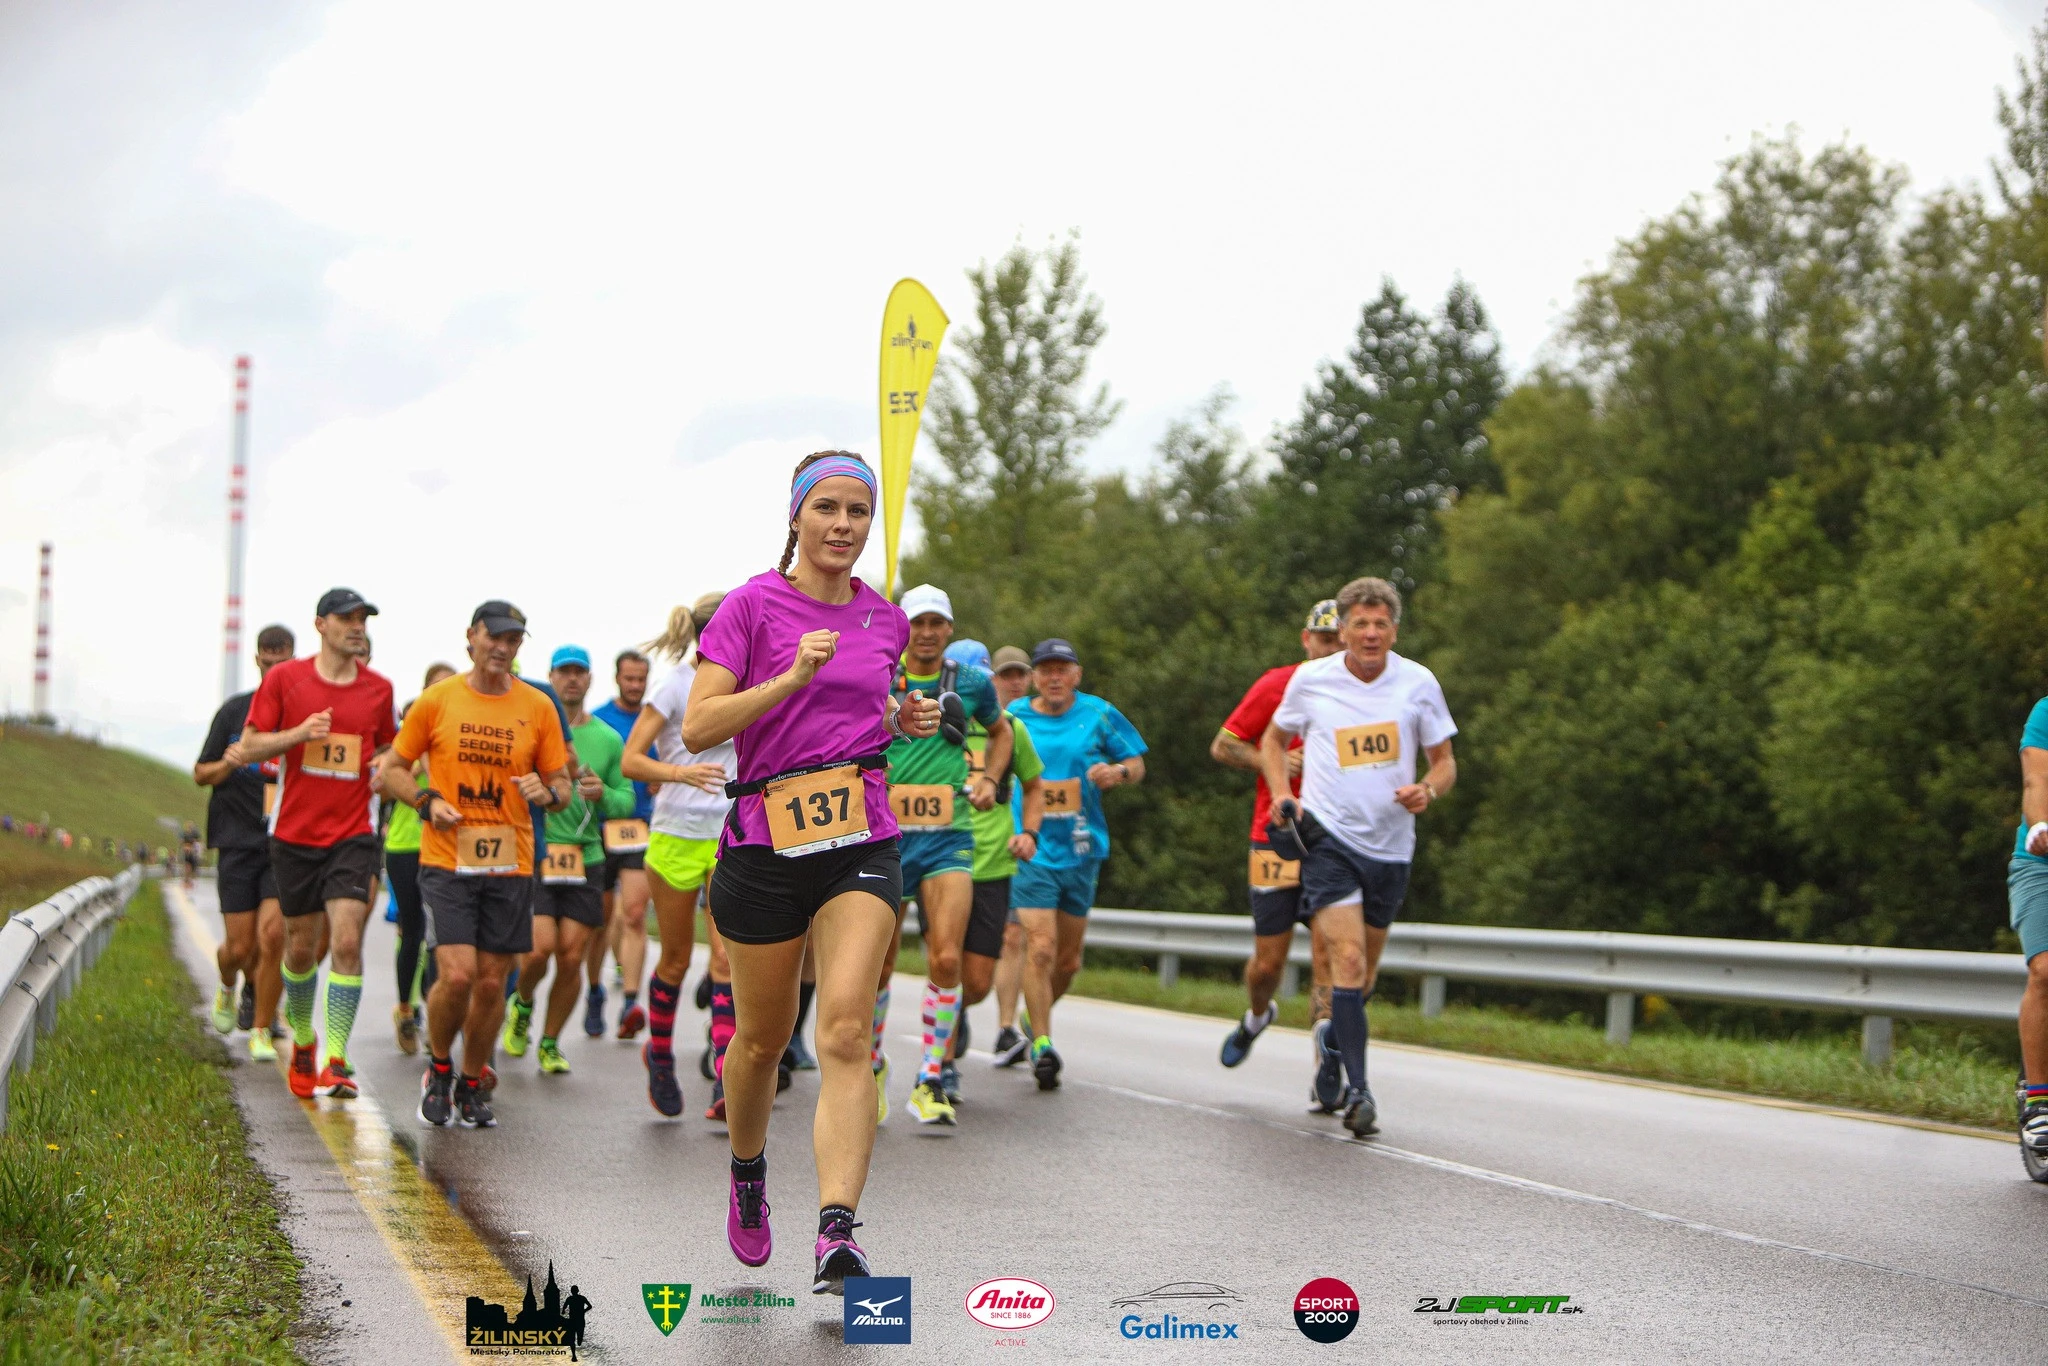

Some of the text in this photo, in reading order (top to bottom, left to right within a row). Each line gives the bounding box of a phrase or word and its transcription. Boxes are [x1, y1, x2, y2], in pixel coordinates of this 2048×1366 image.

[460, 723, 515, 741] BUDEŠ
[322, 744, 346, 764] 13
[459, 738, 514, 755] SEDIEŤ
[1348, 733, 1389, 757] 140
[458, 752, 512, 768] DOMA?
[768, 769, 808, 784] performance
[1043, 789, 1067, 805] 54
[785, 786, 850, 831] 137
[901, 796, 942, 817] 103
[475, 838, 503, 858] 67
[549, 853, 577, 869] 147
